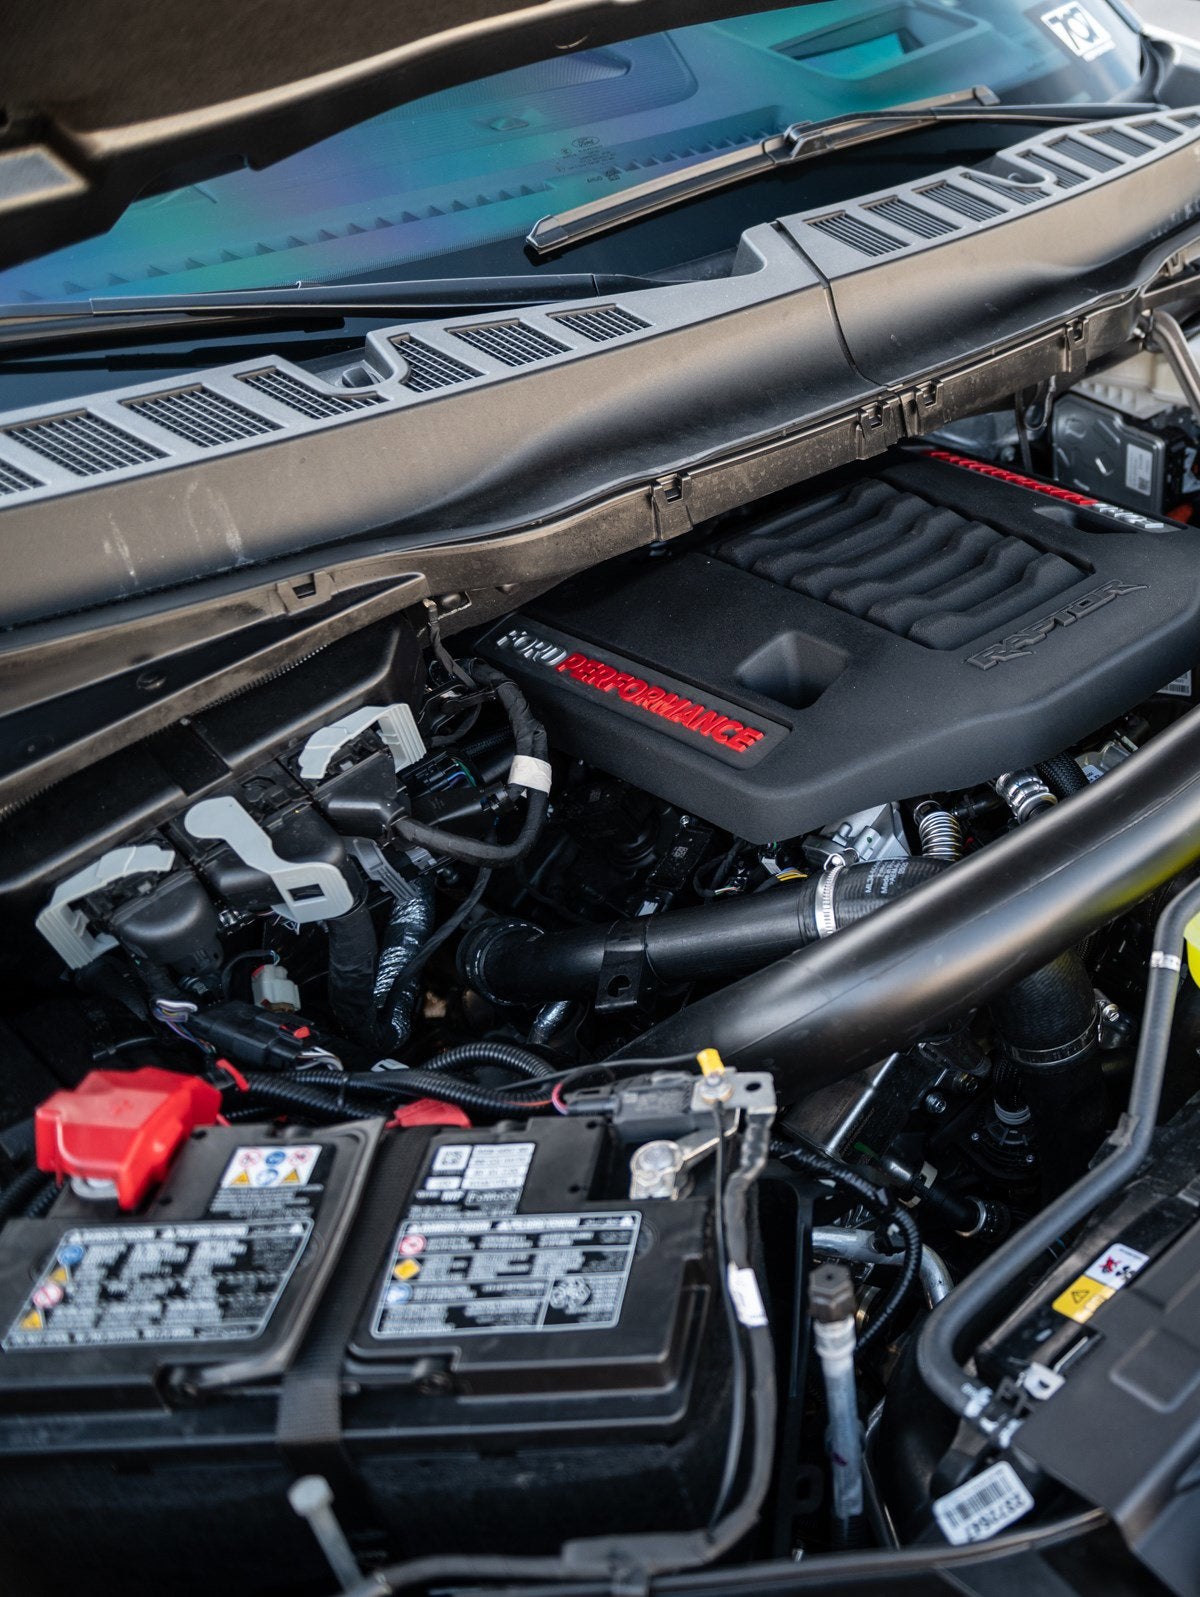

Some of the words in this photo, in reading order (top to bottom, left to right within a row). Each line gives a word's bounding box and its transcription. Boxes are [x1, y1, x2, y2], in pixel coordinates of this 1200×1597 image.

[963, 579, 1150, 671] RAPTOR
[497, 630, 567, 666] FORD
[555, 653, 765, 753] PERFORMANCE
